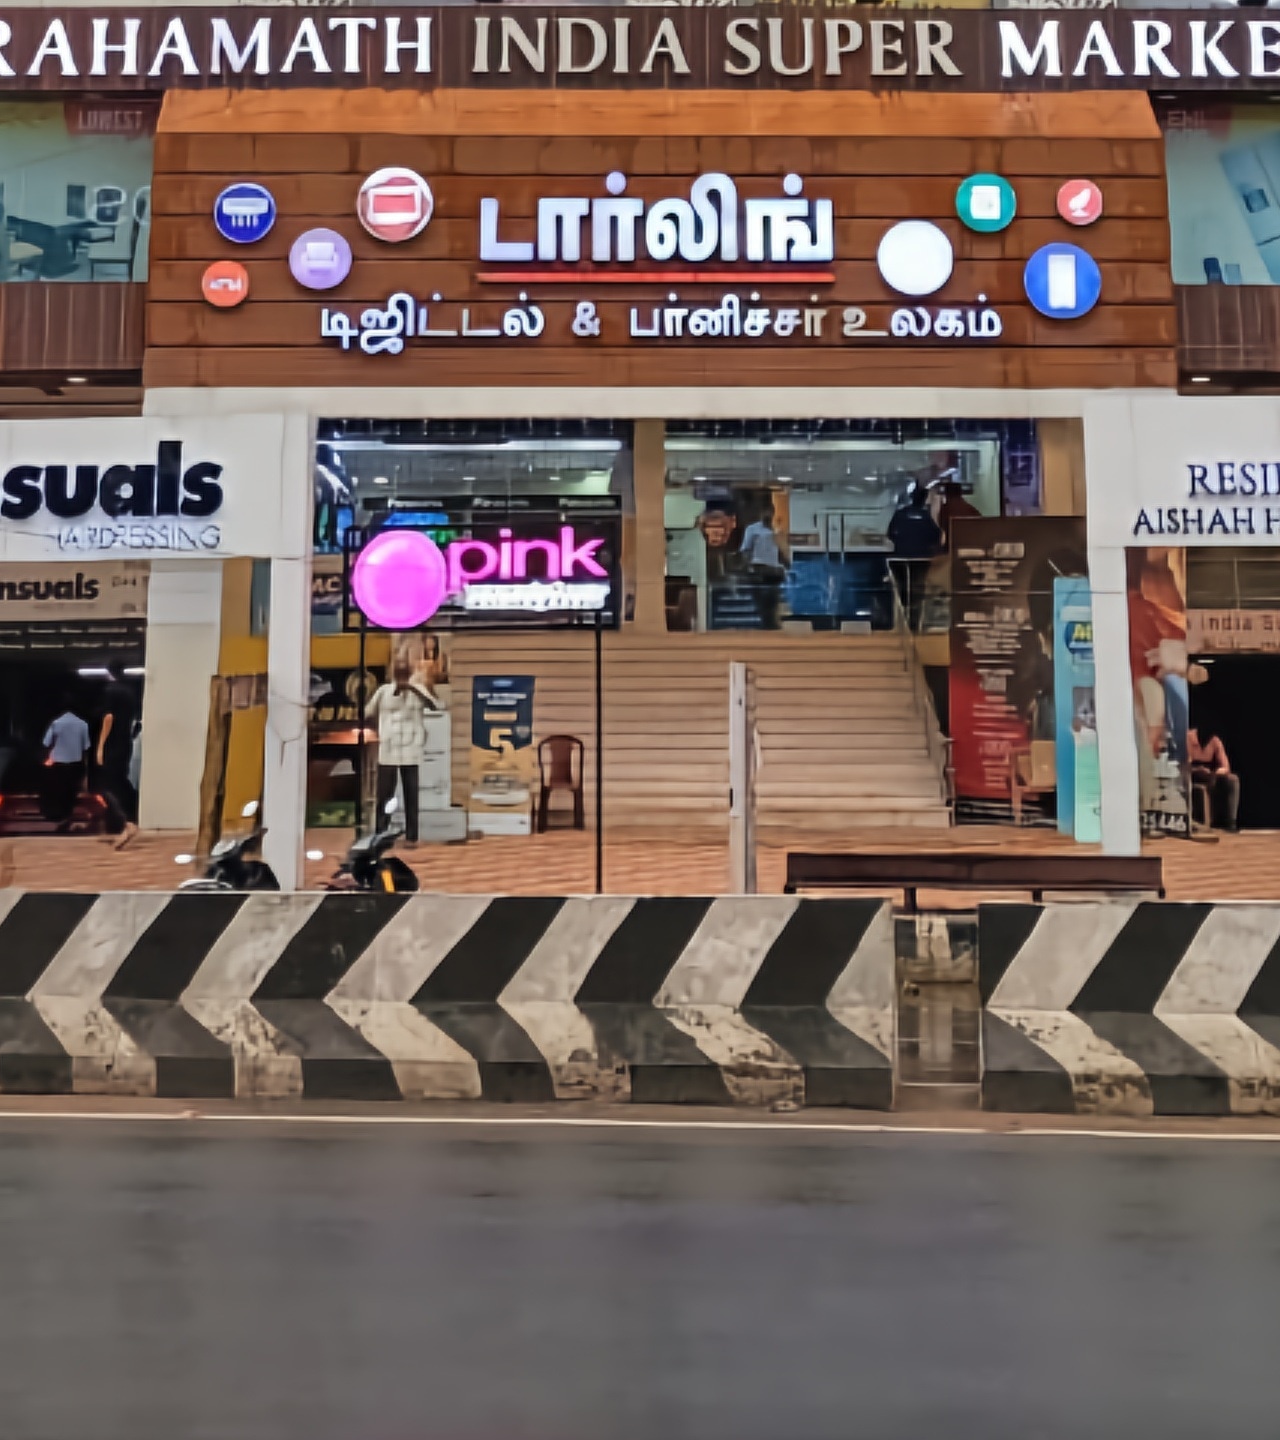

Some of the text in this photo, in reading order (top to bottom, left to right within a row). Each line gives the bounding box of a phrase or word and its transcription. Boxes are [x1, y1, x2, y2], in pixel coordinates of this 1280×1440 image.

[469, 16, 692, 76] INDIA
[722, 16, 965, 78] SUPER
[479, 171, 835, 262] டார்லிங்
[320, 291, 545, 355] டிஜிட்டல்
[571, 301, 601, 338] &
[842, 293, 1004, 338] உலகம்
[1132, 507, 1256, 537] AISHAH
[446, 525, 610, 596] pink
